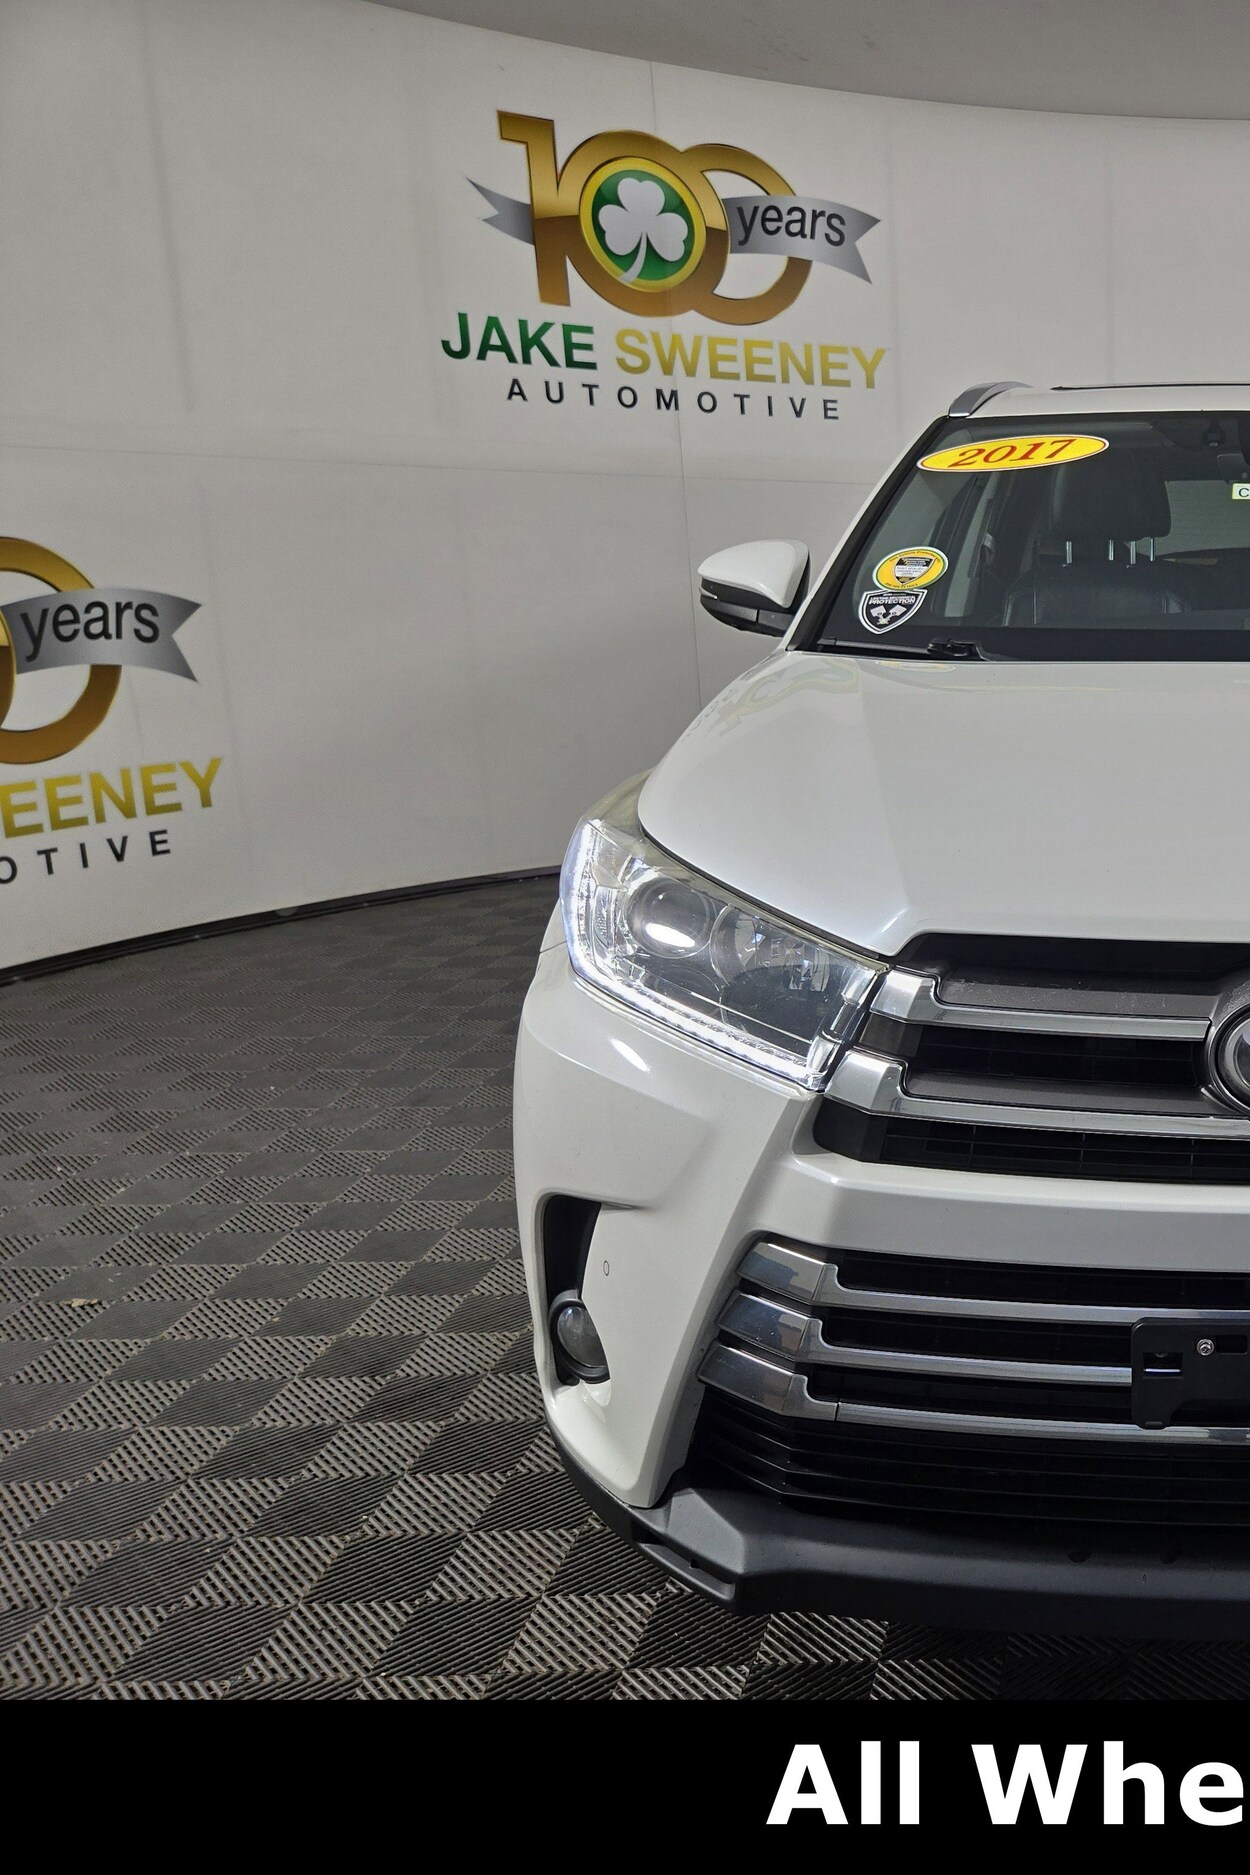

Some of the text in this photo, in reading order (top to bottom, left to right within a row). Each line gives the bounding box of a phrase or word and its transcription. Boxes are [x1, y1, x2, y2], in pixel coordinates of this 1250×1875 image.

[736, 203, 847, 246] years
[441, 312, 887, 389] JAKE SWEENEY
[507, 378, 840, 420] AUTOMOTIVE
[947, 438, 1078, 468] 2017
[20, 600, 160, 662] years
